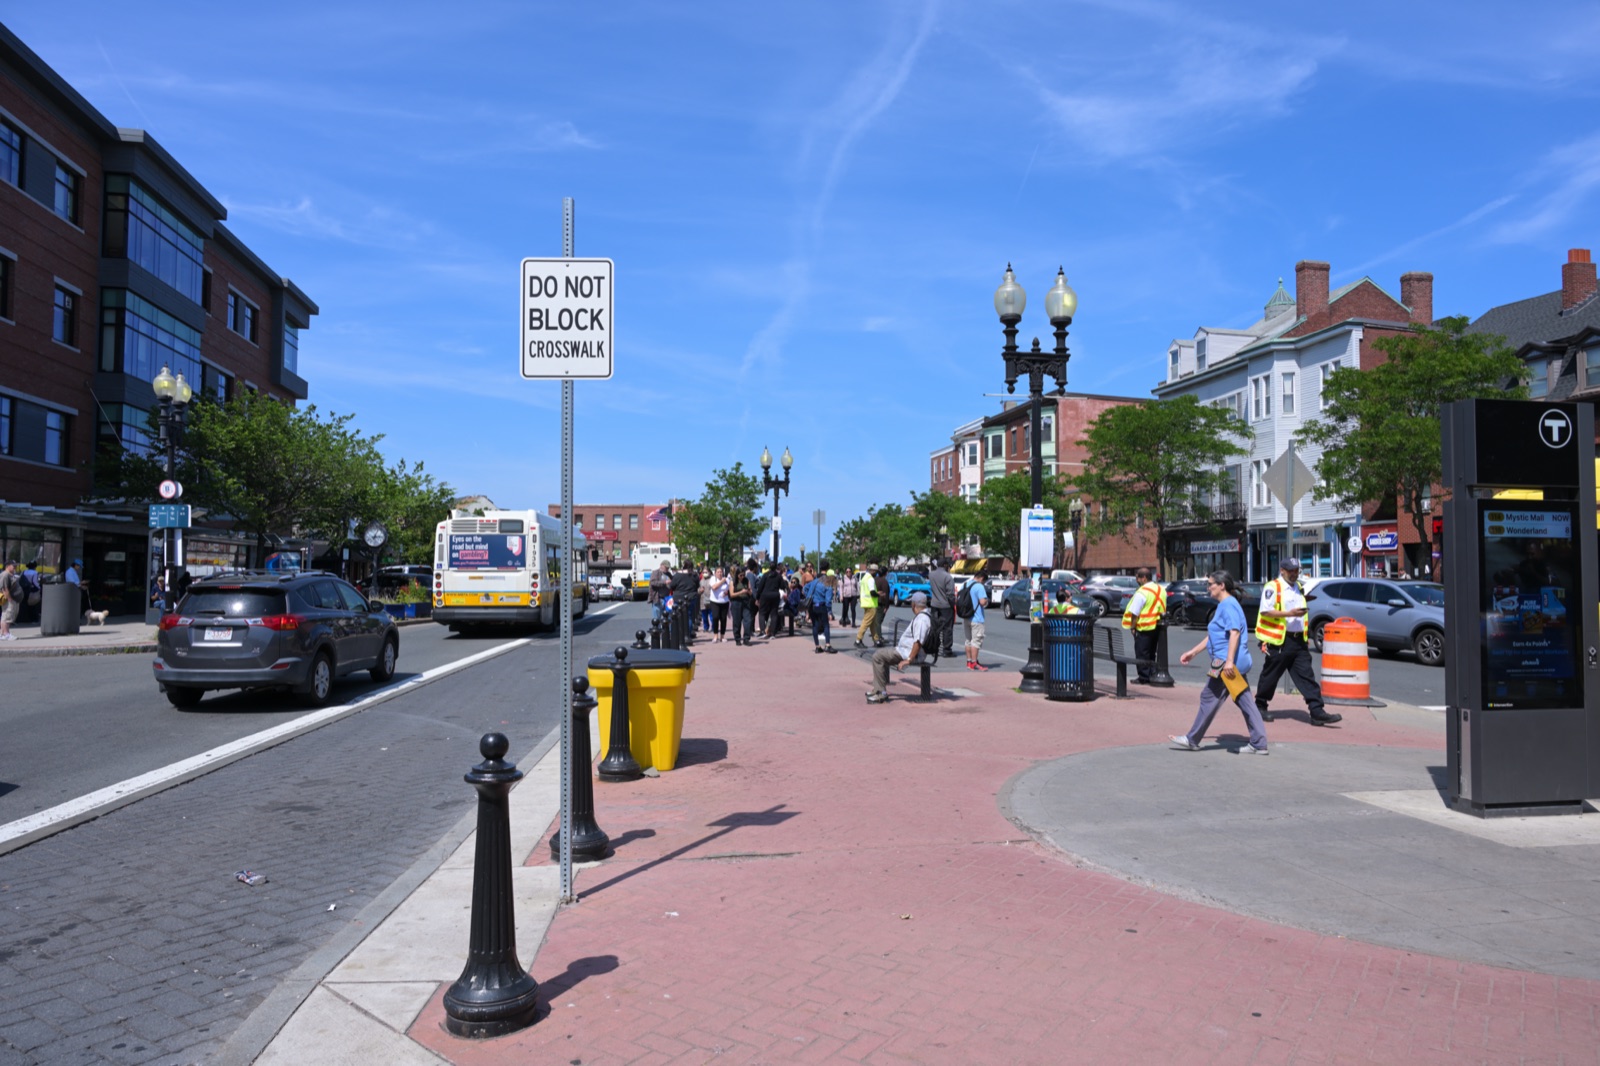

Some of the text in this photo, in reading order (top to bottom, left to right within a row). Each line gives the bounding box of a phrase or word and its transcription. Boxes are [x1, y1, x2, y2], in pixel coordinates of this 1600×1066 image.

[529, 275, 605, 298] DO NOT
[529, 308, 604, 331] BLOCK
[529, 340, 605, 358] CROSSWALK
[1544, 419, 1566, 442] T
[1506, 514, 1528, 522] Mystic
[452, 536, 464, 544] Eyes
